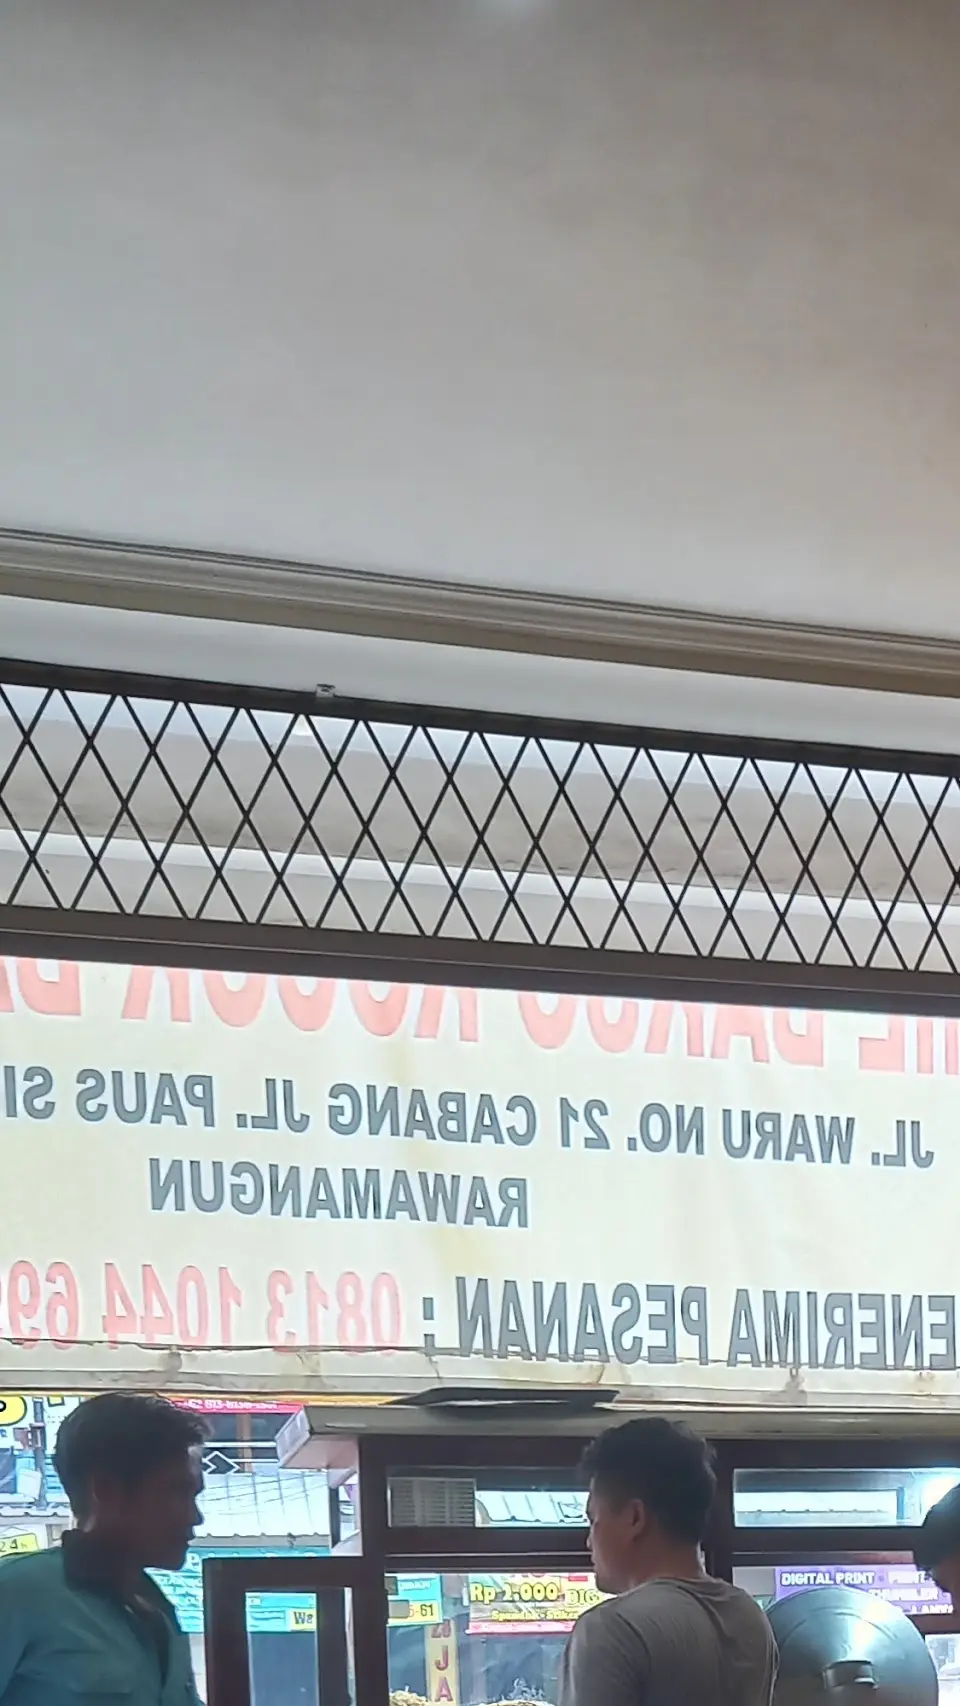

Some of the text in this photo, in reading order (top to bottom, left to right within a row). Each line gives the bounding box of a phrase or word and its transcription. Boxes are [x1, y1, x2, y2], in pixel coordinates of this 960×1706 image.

[781, 1571, 834, 1586] DIGITAL
[836, 1571, 876, 1585] PRINT
[470, 1582, 496, 1605] Rp
